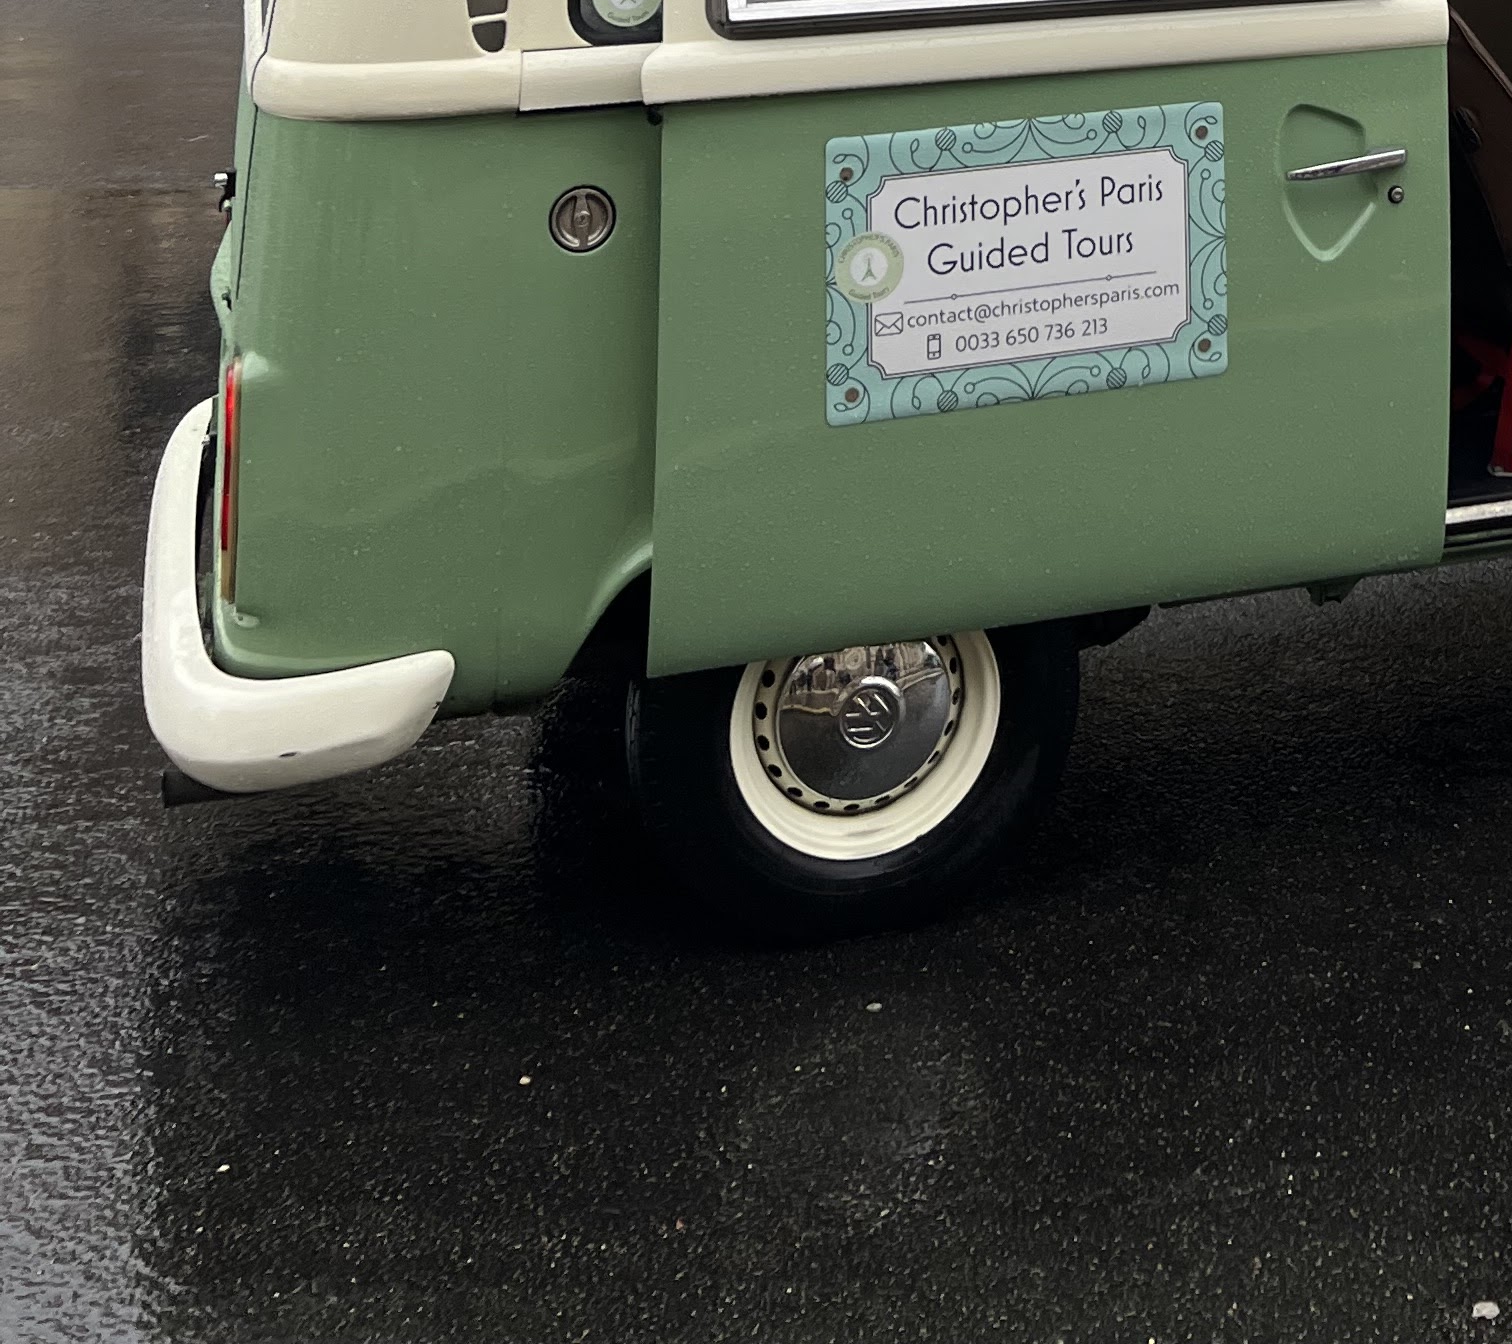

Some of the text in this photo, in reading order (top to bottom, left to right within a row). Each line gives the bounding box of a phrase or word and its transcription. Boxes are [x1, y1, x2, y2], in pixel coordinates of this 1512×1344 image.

[894, 174, 1162, 229] Christopher's Paris
[927, 228, 1133, 275] Guided Tours
[907, 283, 1180, 328] contact@christophersparis.com
[955, 318, 1108, 353] 0033 650 736 213
